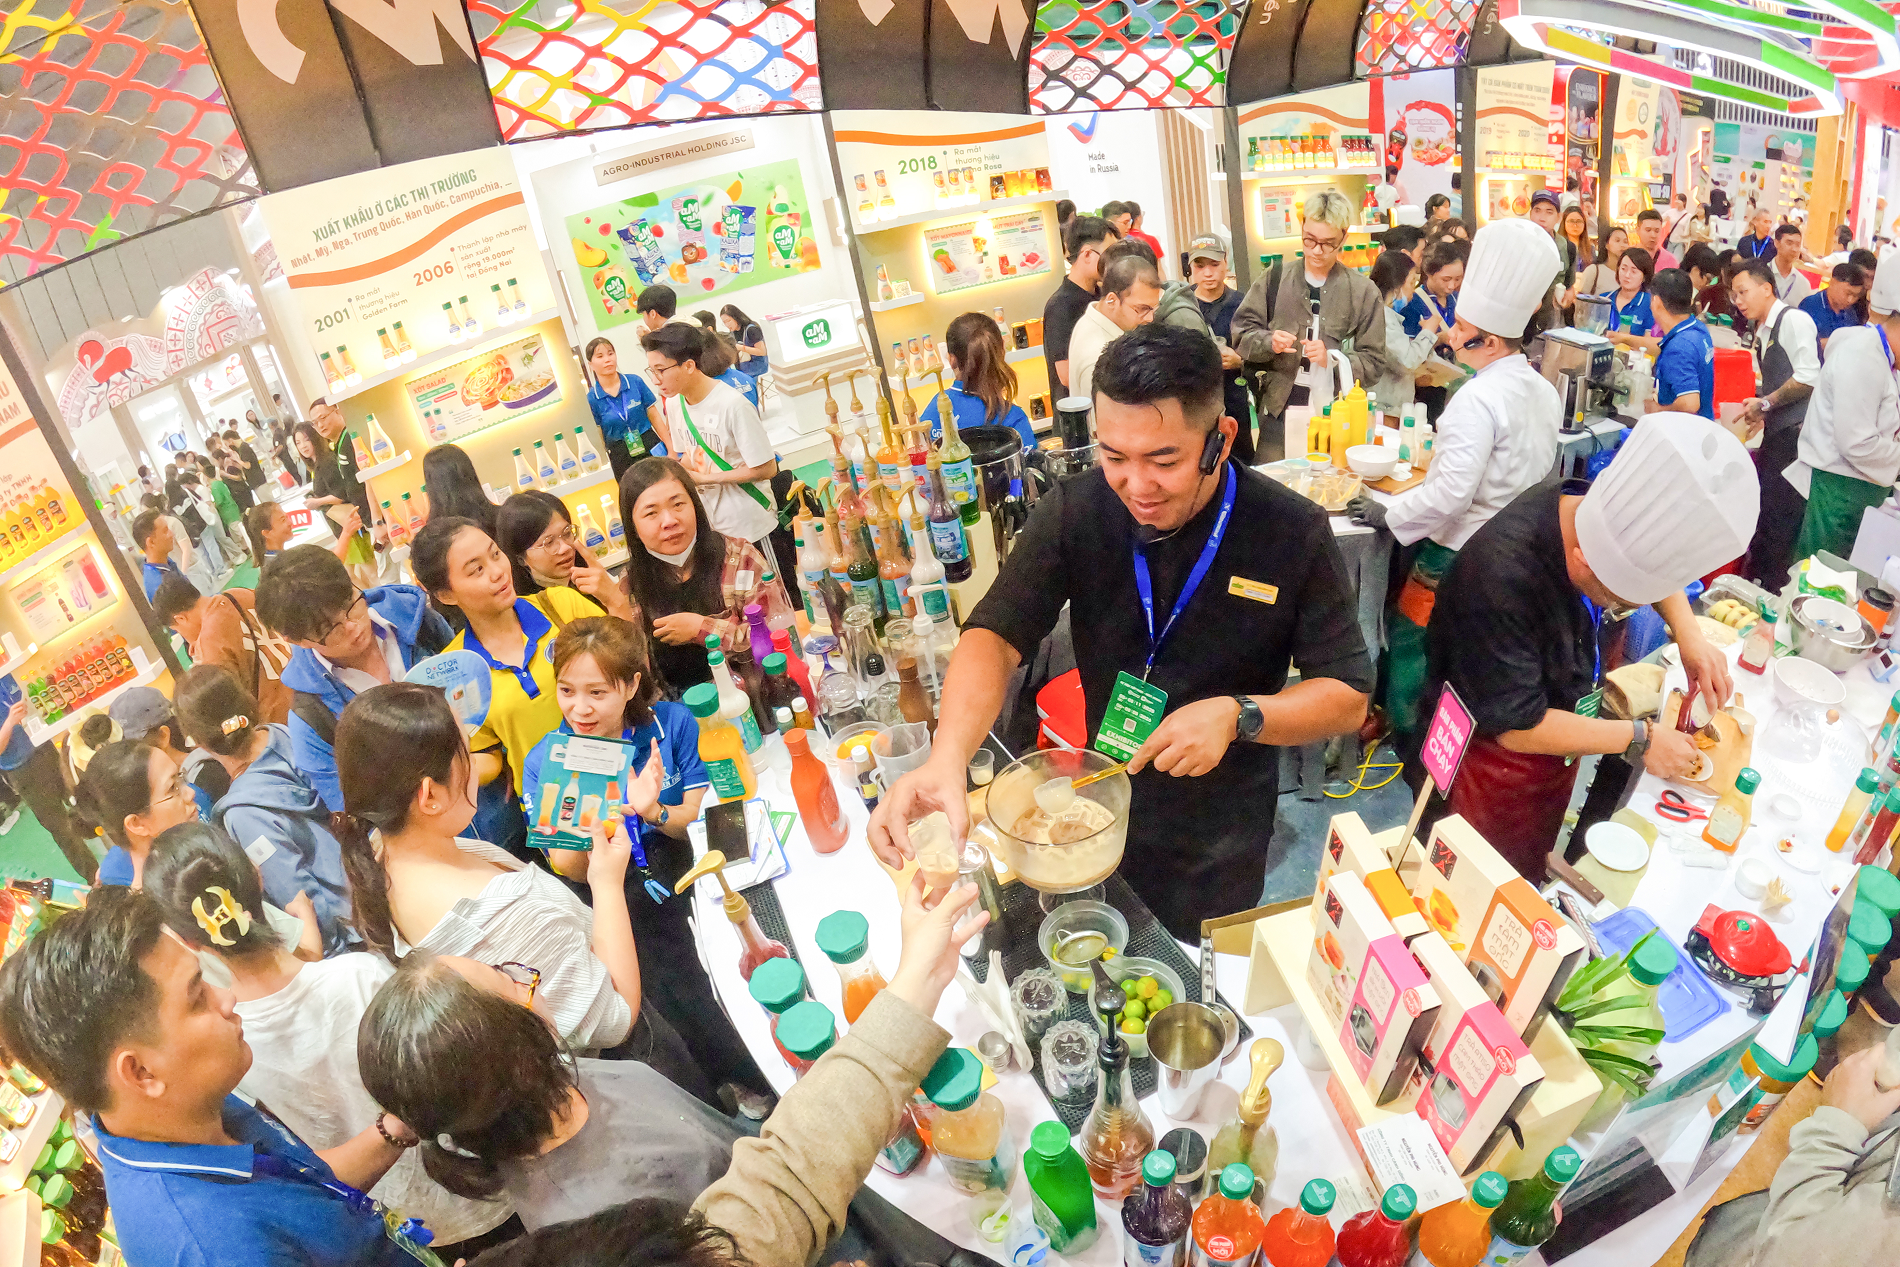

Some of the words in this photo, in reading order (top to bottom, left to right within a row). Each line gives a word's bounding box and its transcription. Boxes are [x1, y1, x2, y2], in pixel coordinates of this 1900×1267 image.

[602, 149, 687, 177] AGRO-INDUSTRIAL
[687, 140, 728, 155] HOLDING
[729, 135, 747, 145] JSC
[954, 148, 966, 156] Ra
[1088, 151, 1105, 161] Made
[898, 155, 938, 175] 2018
[983, 163, 1003, 171] Rosa
[1089, 164, 1096, 173] in
[1097, 163, 1119, 174] Russia
[312, 217, 342, 243] XUẤT
[342, 205, 374, 231] KHẨU
[385, 194, 409, 214] CÁC
[410, 186, 430, 204] THỊ
[430, 168, 477, 197] TRƯỜNG
[332, 236, 353, 251] Nga,
[352, 223, 380, 242] Trung
[404, 207, 422, 222] Hàn
[449, 180, 503, 205] Campuchia,
[457, 239, 481, 253] Thành
[413, 260, 455, 287] 2006
[501, 258, 513, 269] Nai
[354, 292, 366, 303] Ra
[362, 306, 388, 321] Golden
[388, 298, 409, 312] Farm
[313, 307, 351, 334] 2001
[427, 377, 447, 391] SALAD
[1436, 725, 1455, 759] BÁN
[1430, 737, 1452, 774] CHẠY
